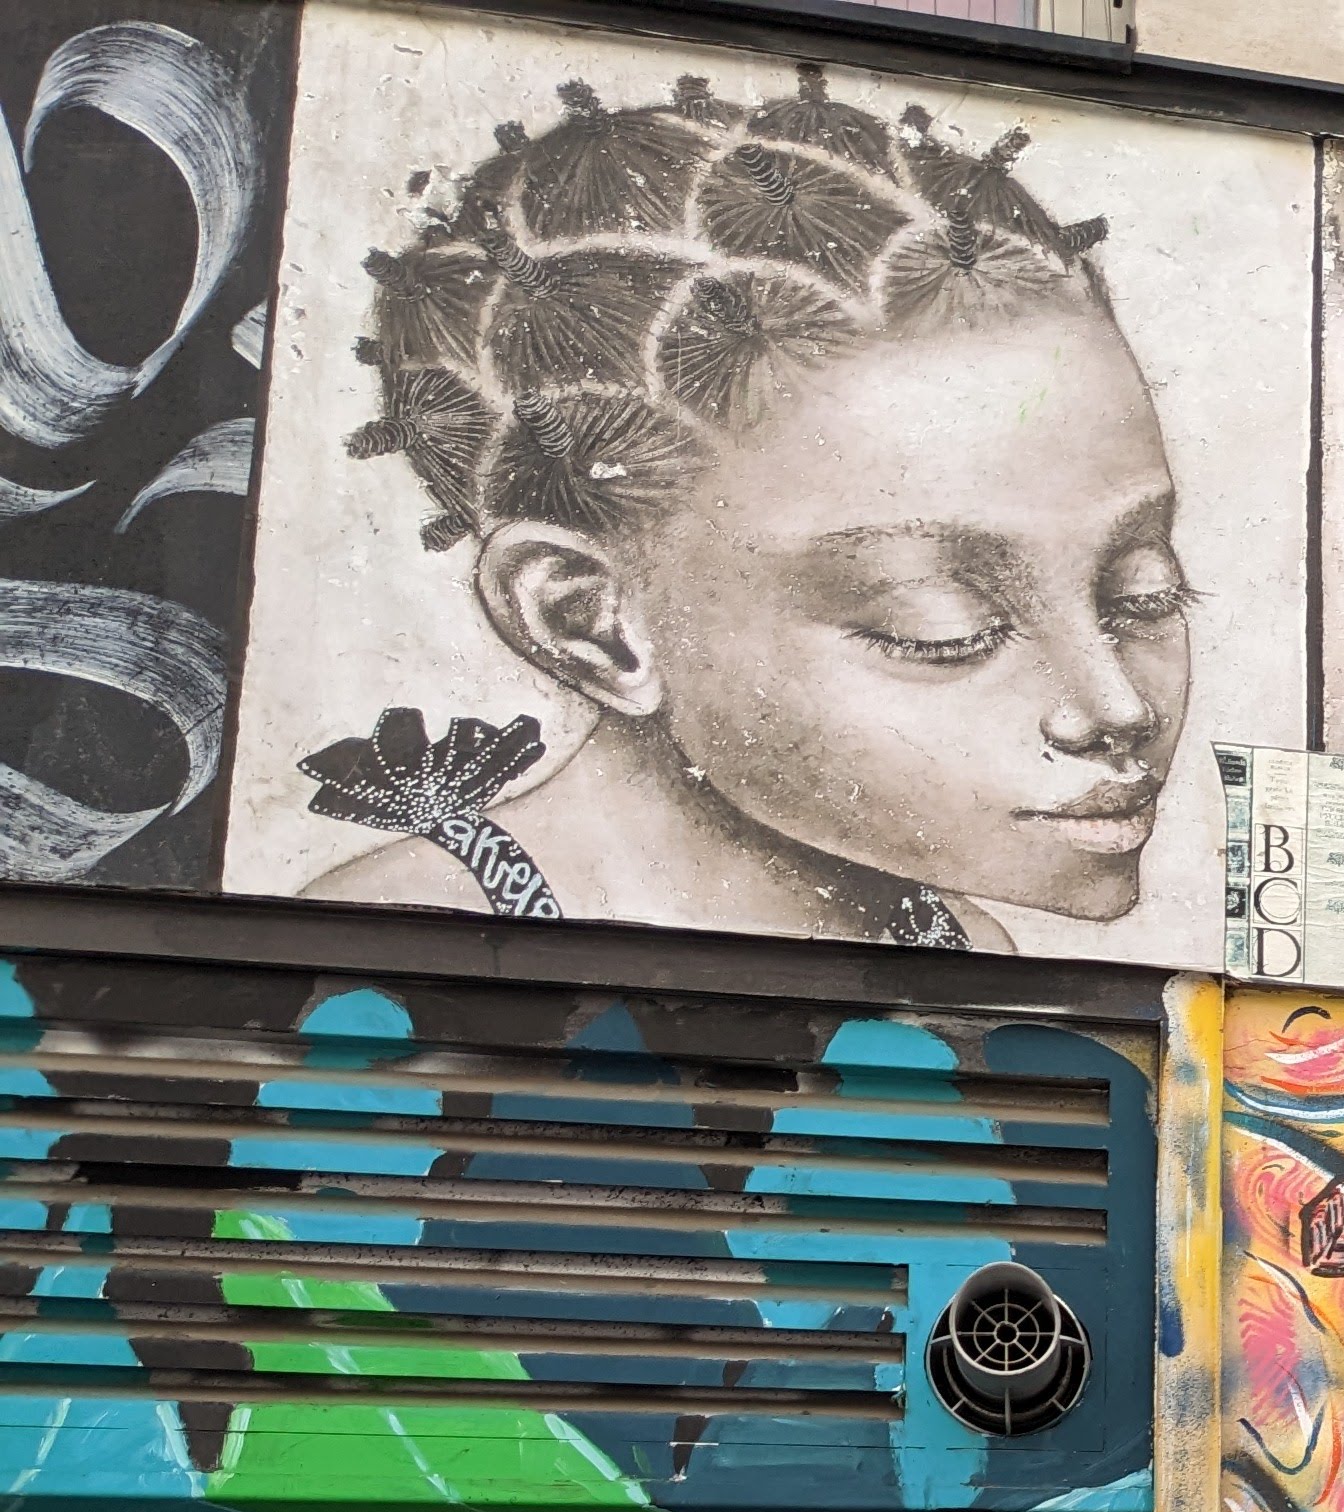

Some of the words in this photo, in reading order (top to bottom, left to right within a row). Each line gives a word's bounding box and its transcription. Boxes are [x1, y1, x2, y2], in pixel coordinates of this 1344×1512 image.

[1261, 825, 1294, 875] B
[1254, 877, 1301, 926] C
[1254, 928, 1301, 978] D
